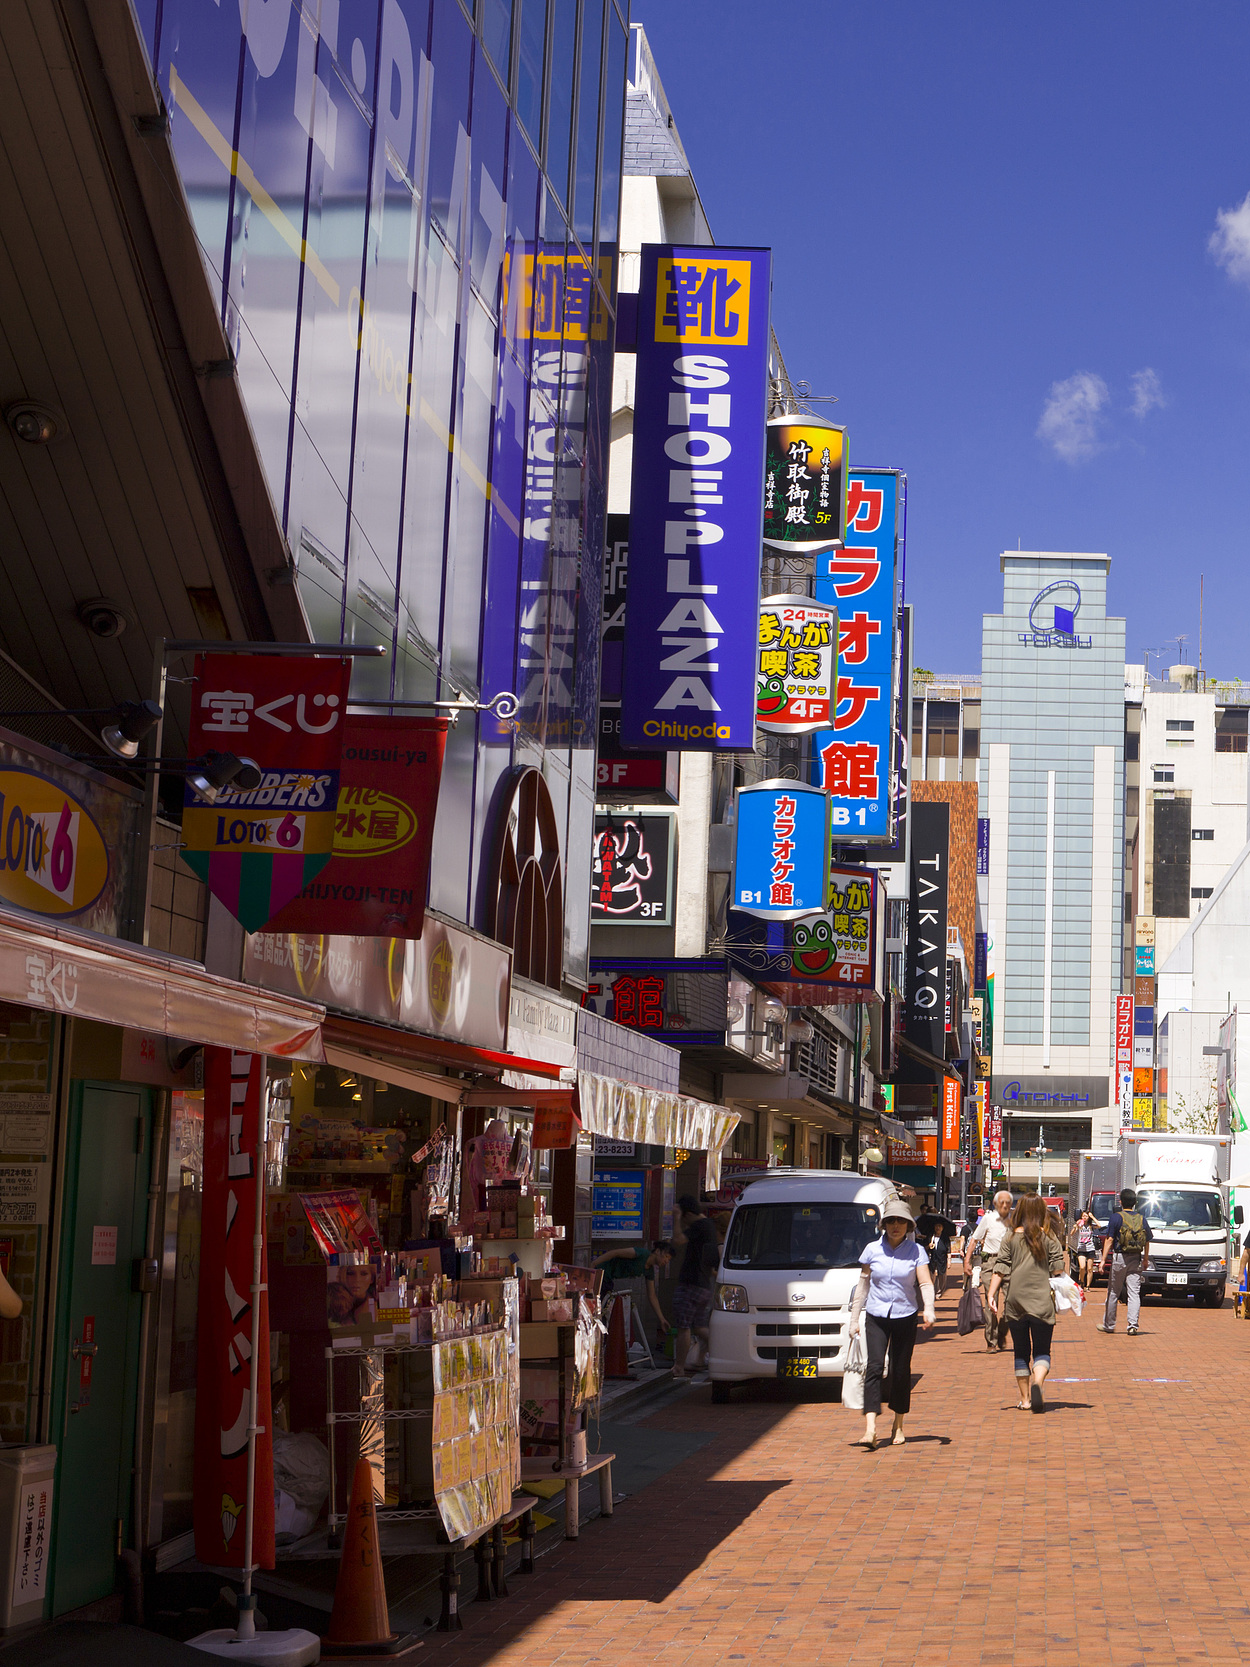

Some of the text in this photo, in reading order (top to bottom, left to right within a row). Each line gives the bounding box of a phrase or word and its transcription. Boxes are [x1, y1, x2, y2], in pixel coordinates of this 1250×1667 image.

[663, 265, 742, 338] 靴
[764, 471, 777, 509] 吉祥寺店
[784, 441, 813, 525] 竹取御殿
[815, 512, 832, 524] 5F
[758, 613, 830, 649] まんが
[820, 478, 885, 800] カラオケ館
[760, 650, 820, 678] 喫茶
[787, 685, 827, 695] ゲラゲラ
[201, 690, 340, 735] 宝くじ
[789, 700, 823, 718] 4F
[642, 719, 731, 741] Chiyoda
[342, 743, 428, 767] ousui-ya
[597, 763, 629, 783] 3F
[832, 806, 867, 826] B1
[215, 812, 302, 848] LOTO 6
[51, 800, 74, 892] 6
[769, 795, 798, 906] カラオケ館
[741, 891, 762, 903] B1
[640, 902, 664, 917] 3F
[834, 914, 868, 938] 喫茶
[836, 940, 867, 951] ゲラゲラ
[25, 954, 78, 1009] 宝くじ
[839, 964, 864, 982] 4F
[1118, 998, 1131, 1047] カラオケ
[1019, 1092, 1090, 1101] TOKYU
[945, 1105, 954, 1139] Kitchen
[891, 1149, 928, 1157] Kitchen
[785, 1365, 817, 1378] 26-62
